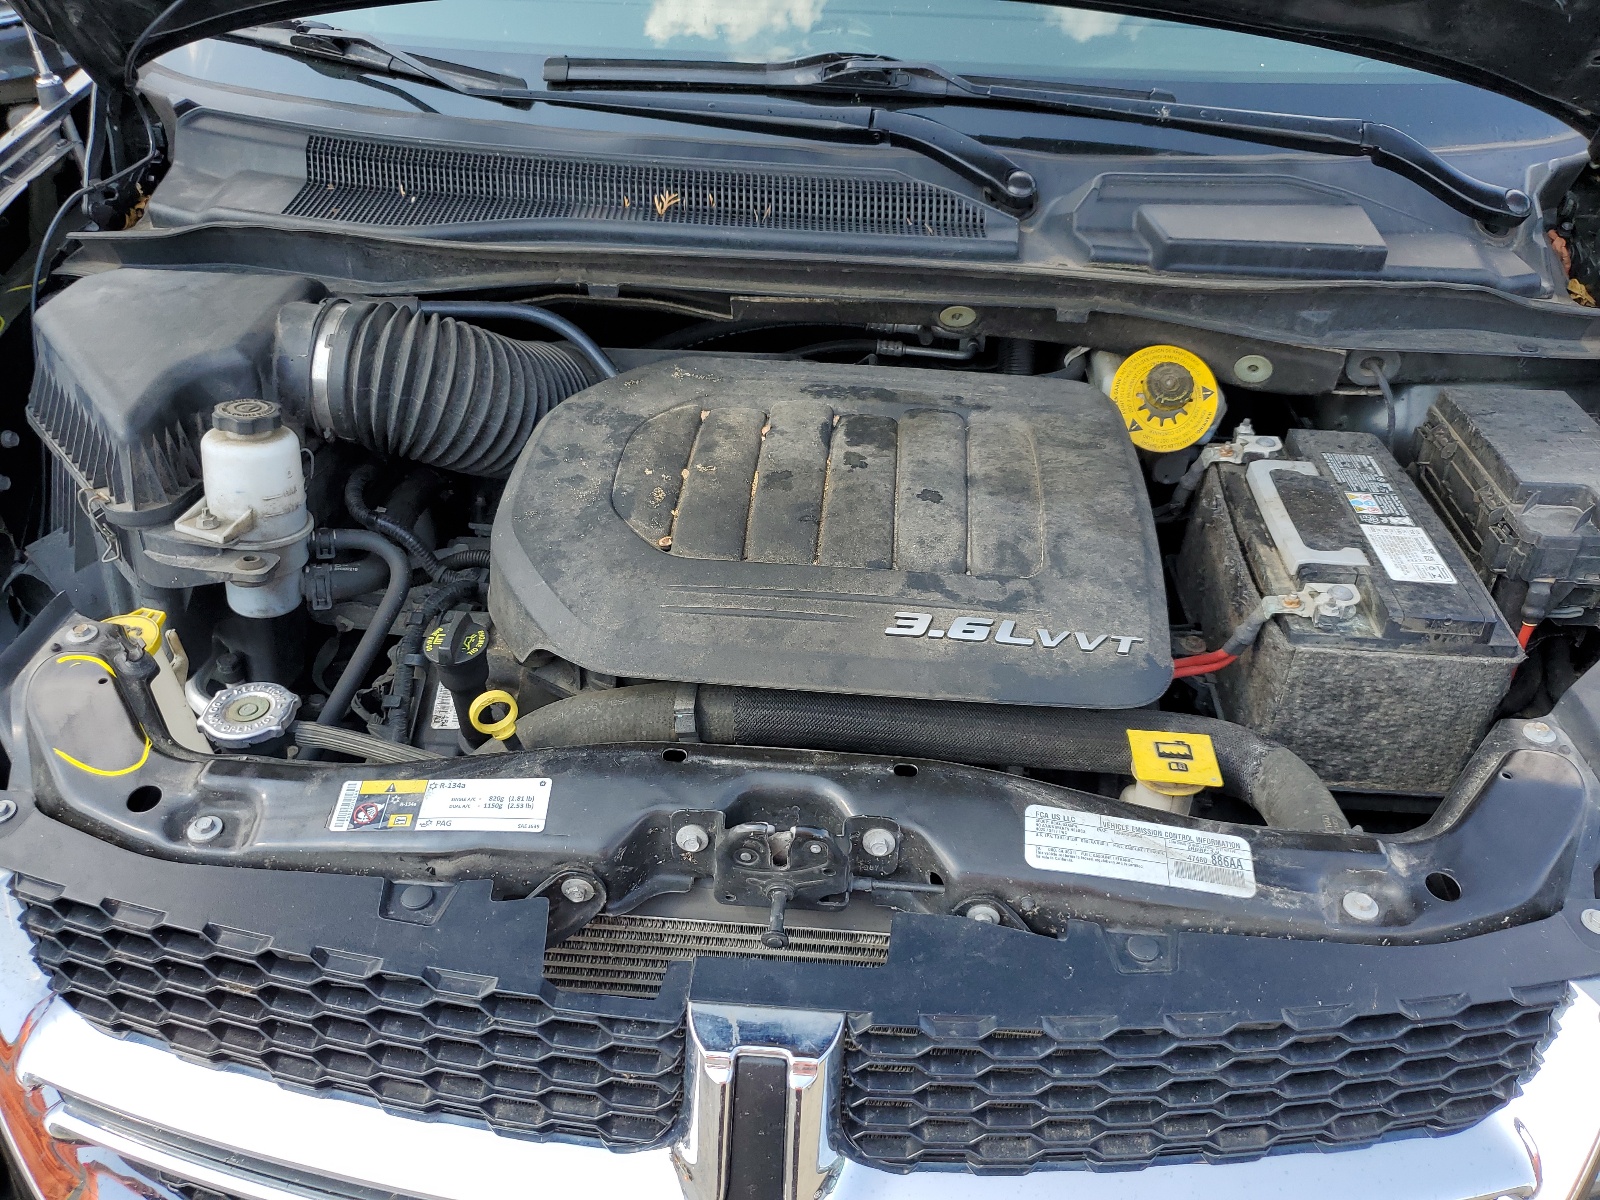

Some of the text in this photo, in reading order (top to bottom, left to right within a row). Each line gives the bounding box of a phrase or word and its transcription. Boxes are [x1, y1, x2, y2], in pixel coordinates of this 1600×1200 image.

[1035, 811, 1076, 823] FCA US LLC
[1102, 821, 1129, 831] VEHICLE
[1131, 825, 1163, 837] EMISSION
[1164, 831, 1193, 841] CONTROL
[1195, 836, 1241, 849] INFORMATION
[1211, 854, 1244, 870] 886AA
